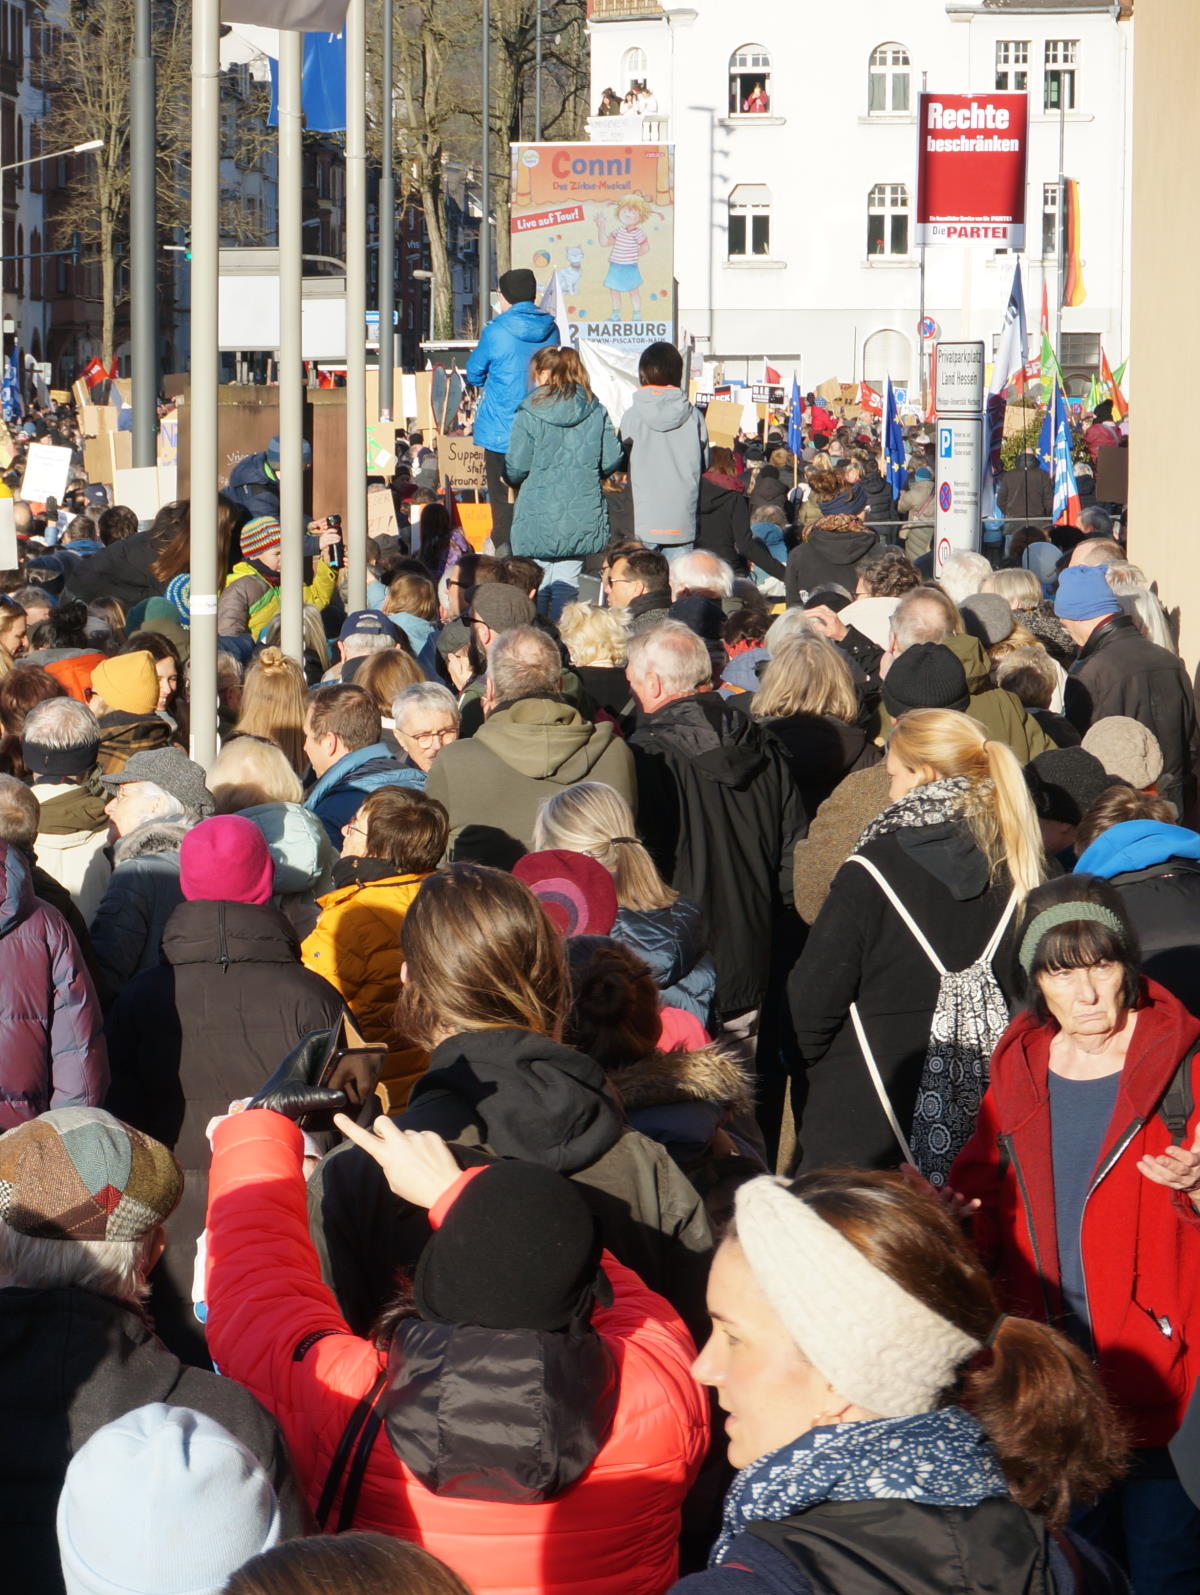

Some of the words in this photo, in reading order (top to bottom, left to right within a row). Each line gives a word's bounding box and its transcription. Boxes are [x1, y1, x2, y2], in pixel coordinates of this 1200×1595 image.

[928, 102, 1010, 130] Rechte
[926, 134, 1020, 152] beschränken
[551, 147, 632, 179] Conni
[516, 218, 537, 230] Live
[538, 212, 554, 226] auf
[554, 208, 580, 222] Tour!
[932, 225, 946, 235] Die
[946, 226, 1009, 239] PARTEI
[587, 323, 667, 337] MARBURG
[941, 430, 951, 456] P
